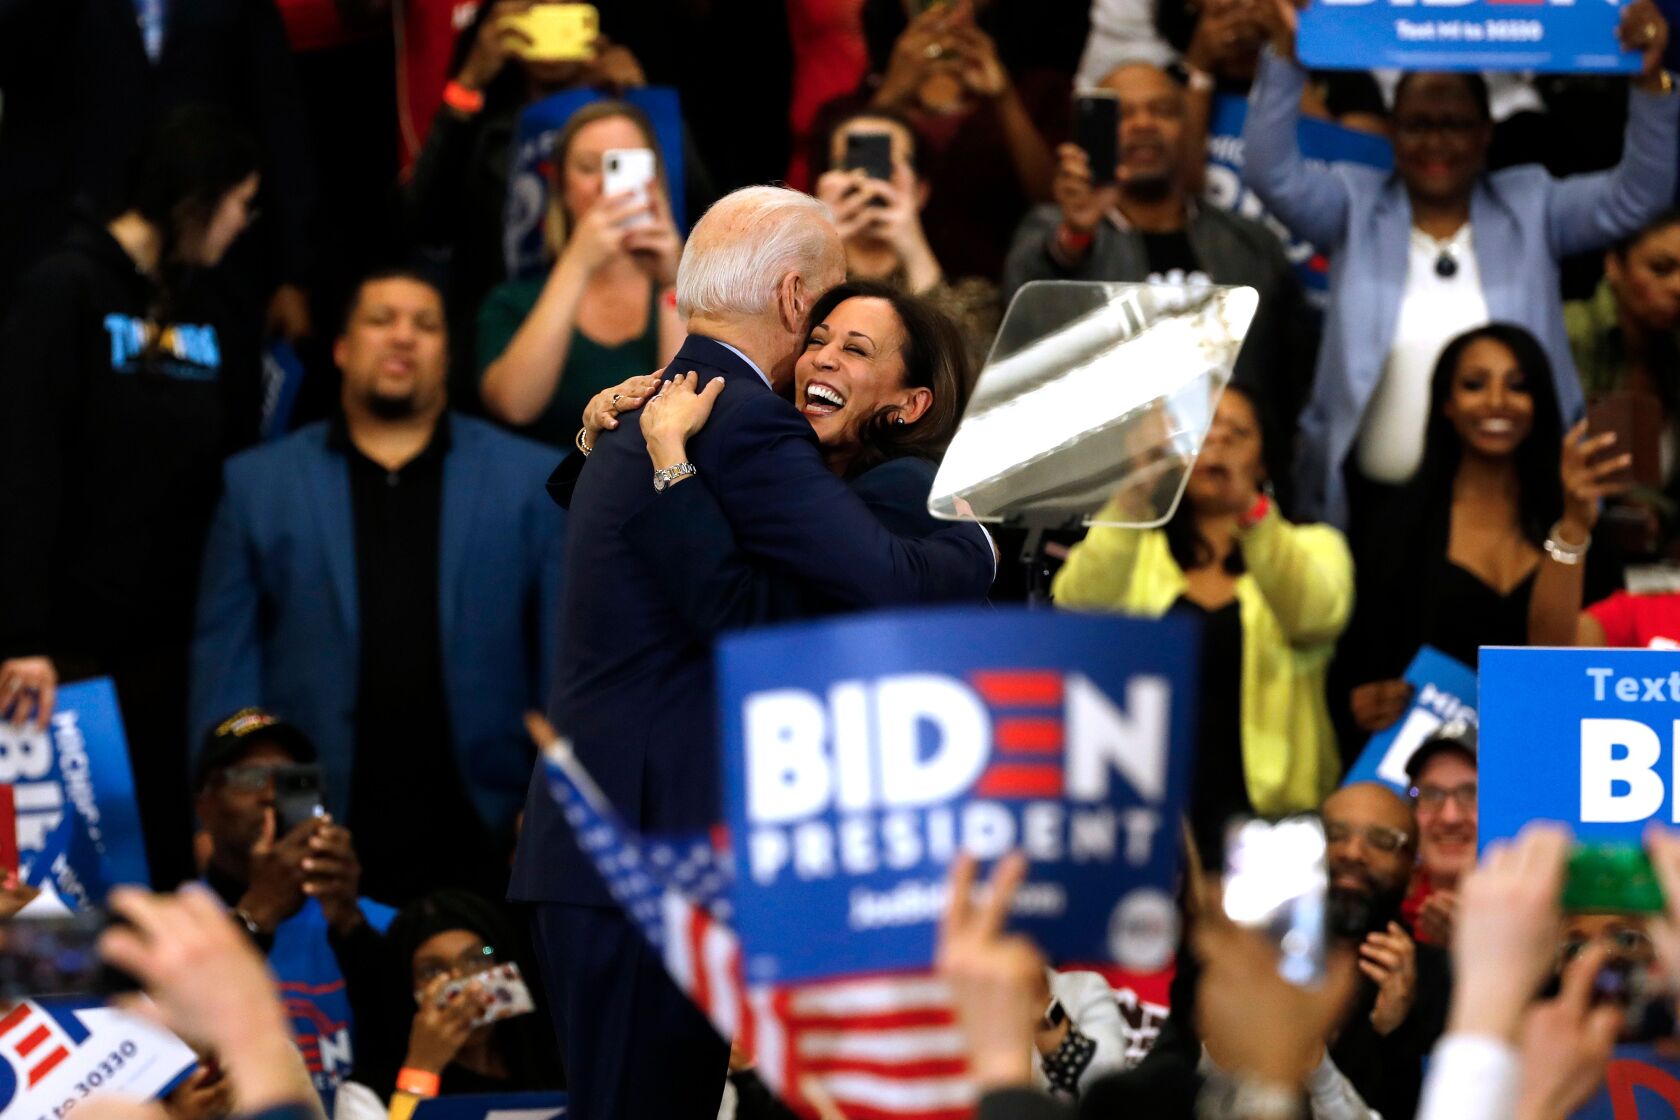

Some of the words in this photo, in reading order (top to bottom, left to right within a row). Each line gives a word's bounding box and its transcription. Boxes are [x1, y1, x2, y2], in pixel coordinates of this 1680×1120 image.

[744, 669, 1171, 822] BIDEN
[1580, 718, 1680, 823] B
[748, 802, 1161, 885] PRESIDENT
[74, 1039, 138, 1097] 30330
